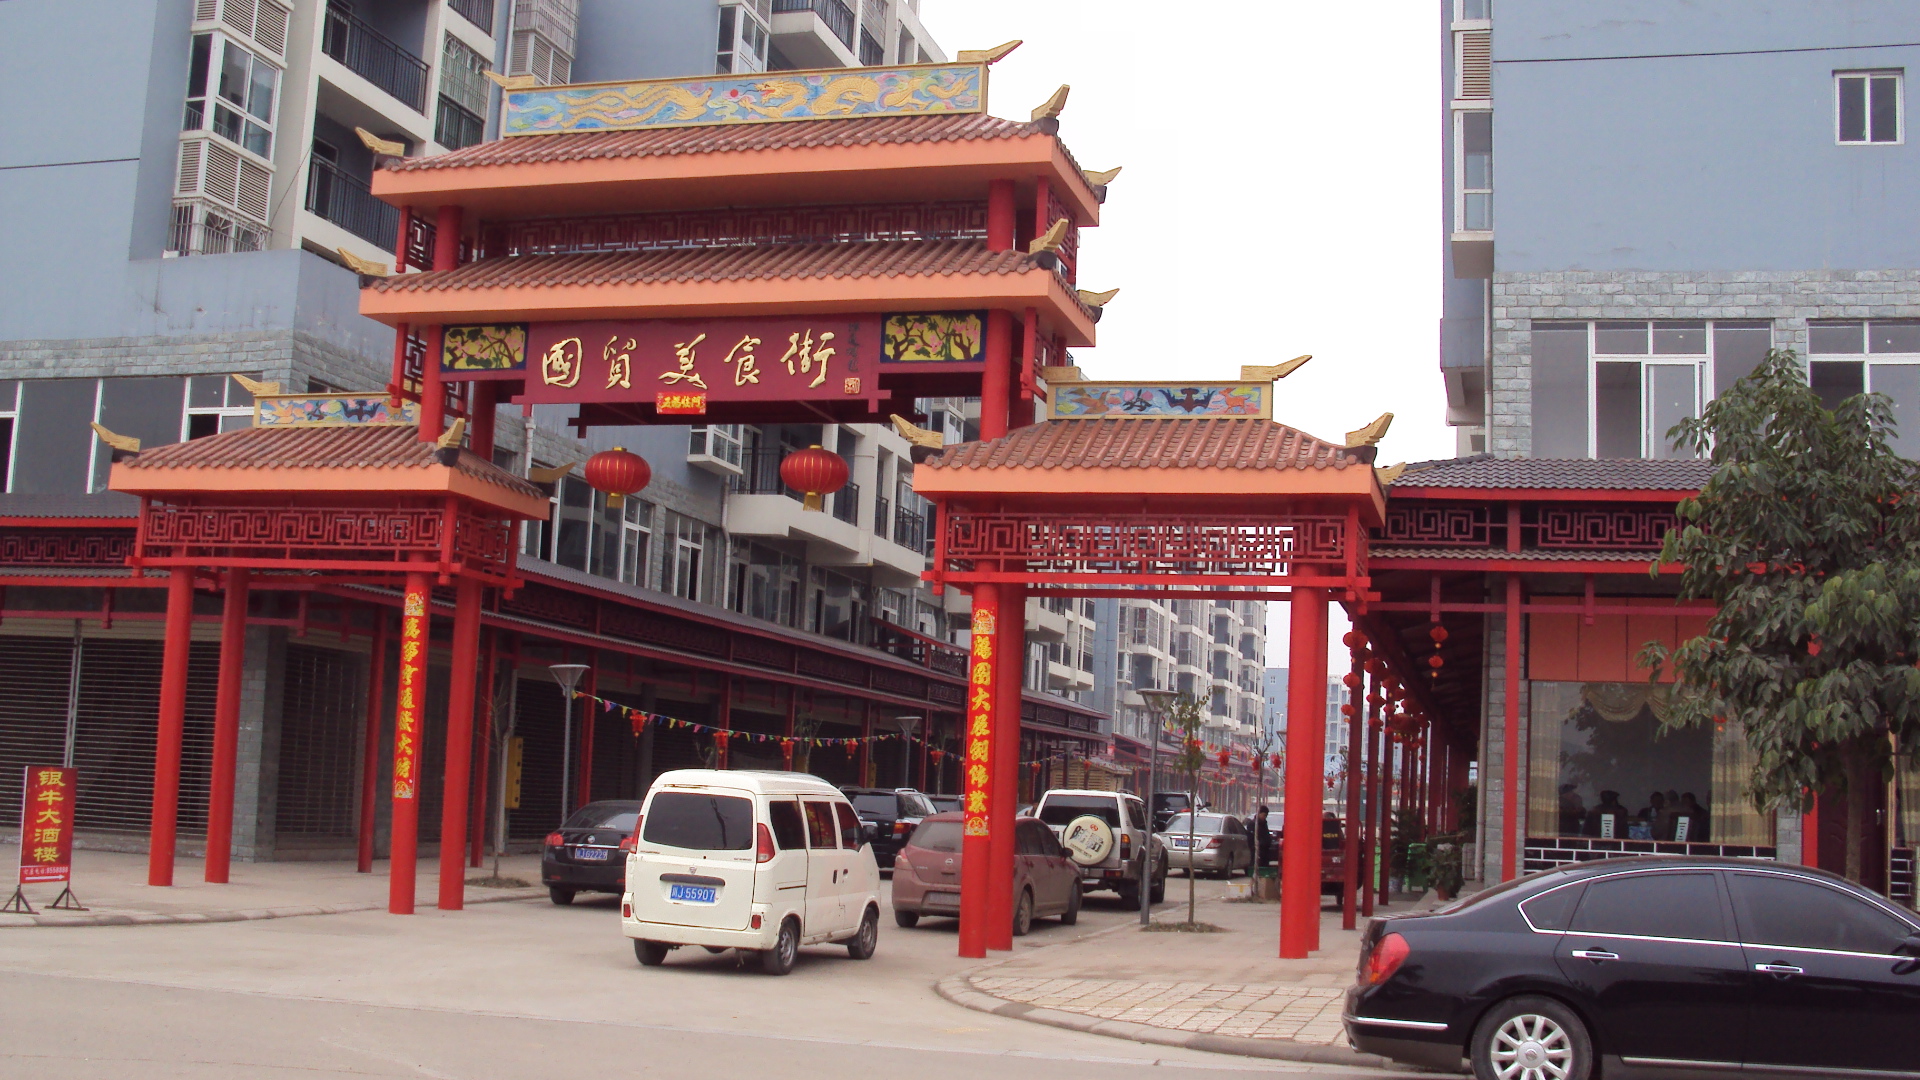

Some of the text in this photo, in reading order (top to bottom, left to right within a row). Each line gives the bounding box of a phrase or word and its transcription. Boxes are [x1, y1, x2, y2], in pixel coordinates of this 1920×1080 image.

[33, 770, 66, 862] 银牛大酒楼
